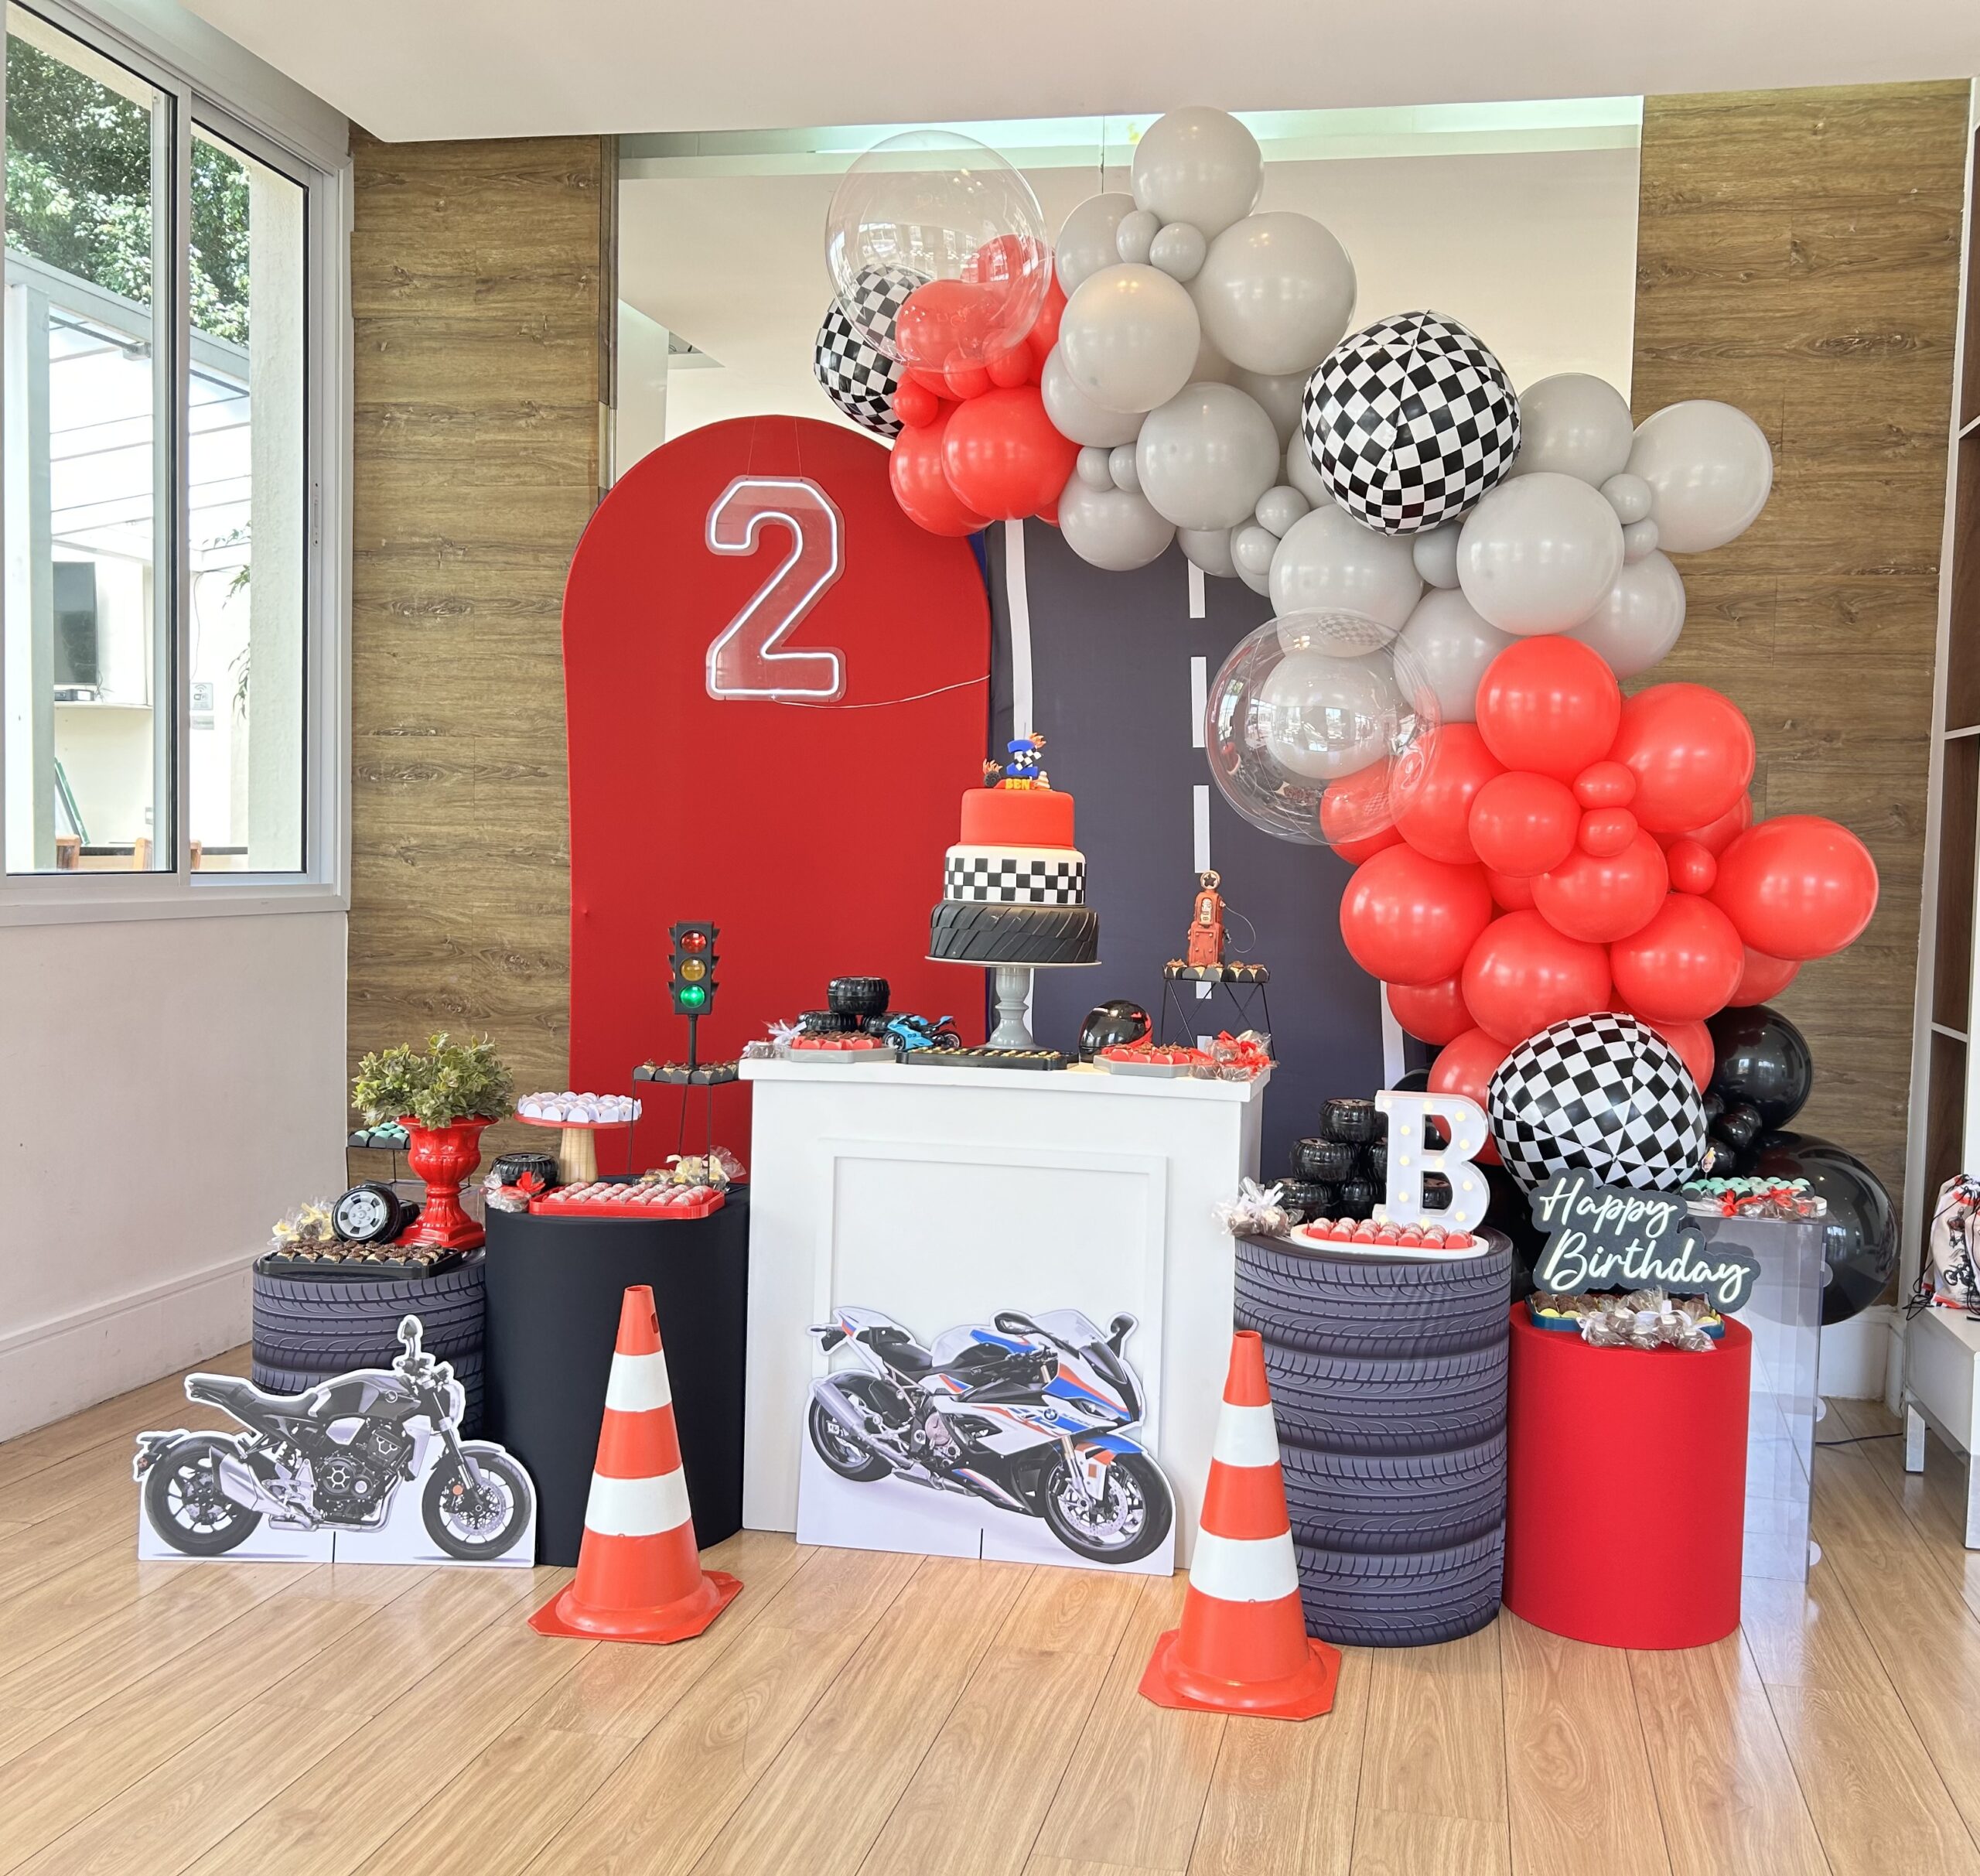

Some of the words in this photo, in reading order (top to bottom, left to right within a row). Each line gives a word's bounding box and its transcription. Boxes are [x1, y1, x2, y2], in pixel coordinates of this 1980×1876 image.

[709, 479, 840, 698] 2
[1005, 778, 1031, 790] BEN
[1372, 1089, 1490, 1235] B
[1539, 1177, 1678, 1239] Happy
[1543, 1228, 1751, 1304] Birthday
